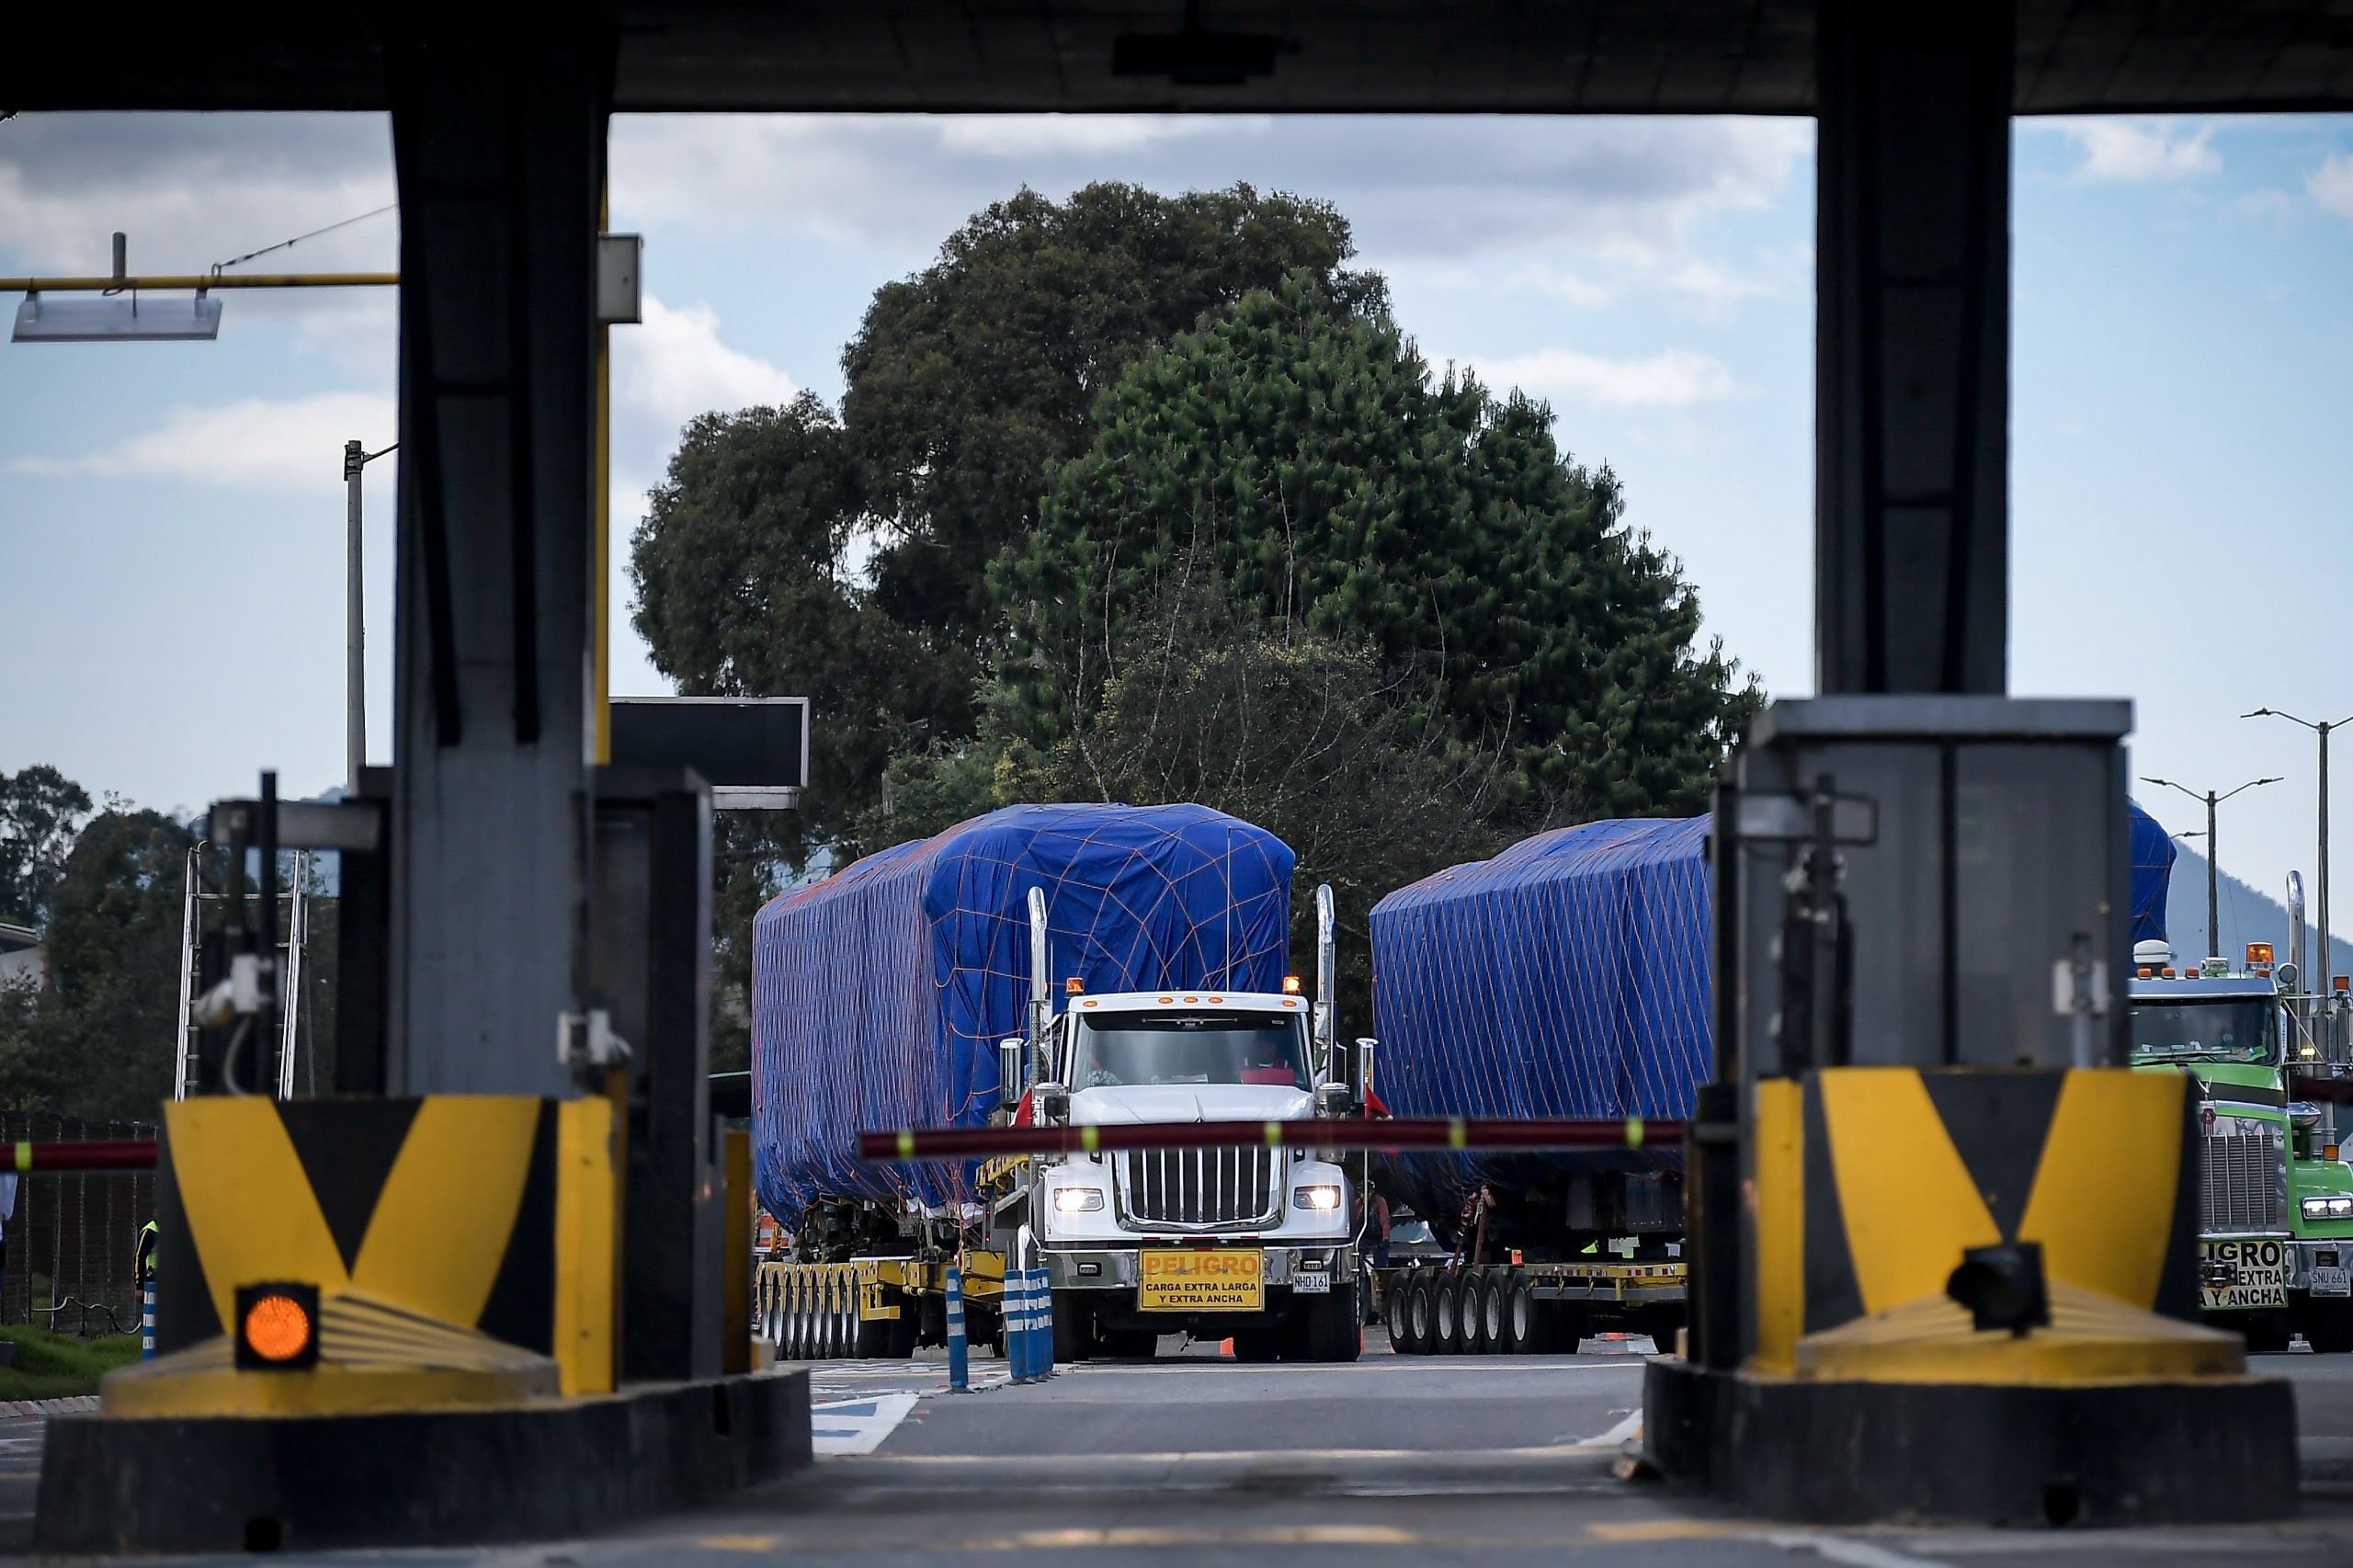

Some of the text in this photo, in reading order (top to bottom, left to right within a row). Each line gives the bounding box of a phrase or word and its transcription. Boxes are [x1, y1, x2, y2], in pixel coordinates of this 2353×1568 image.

[2200, 1242, 2280, 1267] IGRO
[1145, 1256, 1258, 1276] PELIGRO
[2239, 1270, 2283, 1286] EXTRA
[2332, 1271, 2347, 1284] 661
[1145, 1282, 1257, 1292] CARGA EXTRA LARGA
[1159, 1294, 1244, 1303] Y EXTRA ANCHA
[2211, 1290, 2222, 1306] Y
[2227, 1288, 2285, 1305] ANCHA
